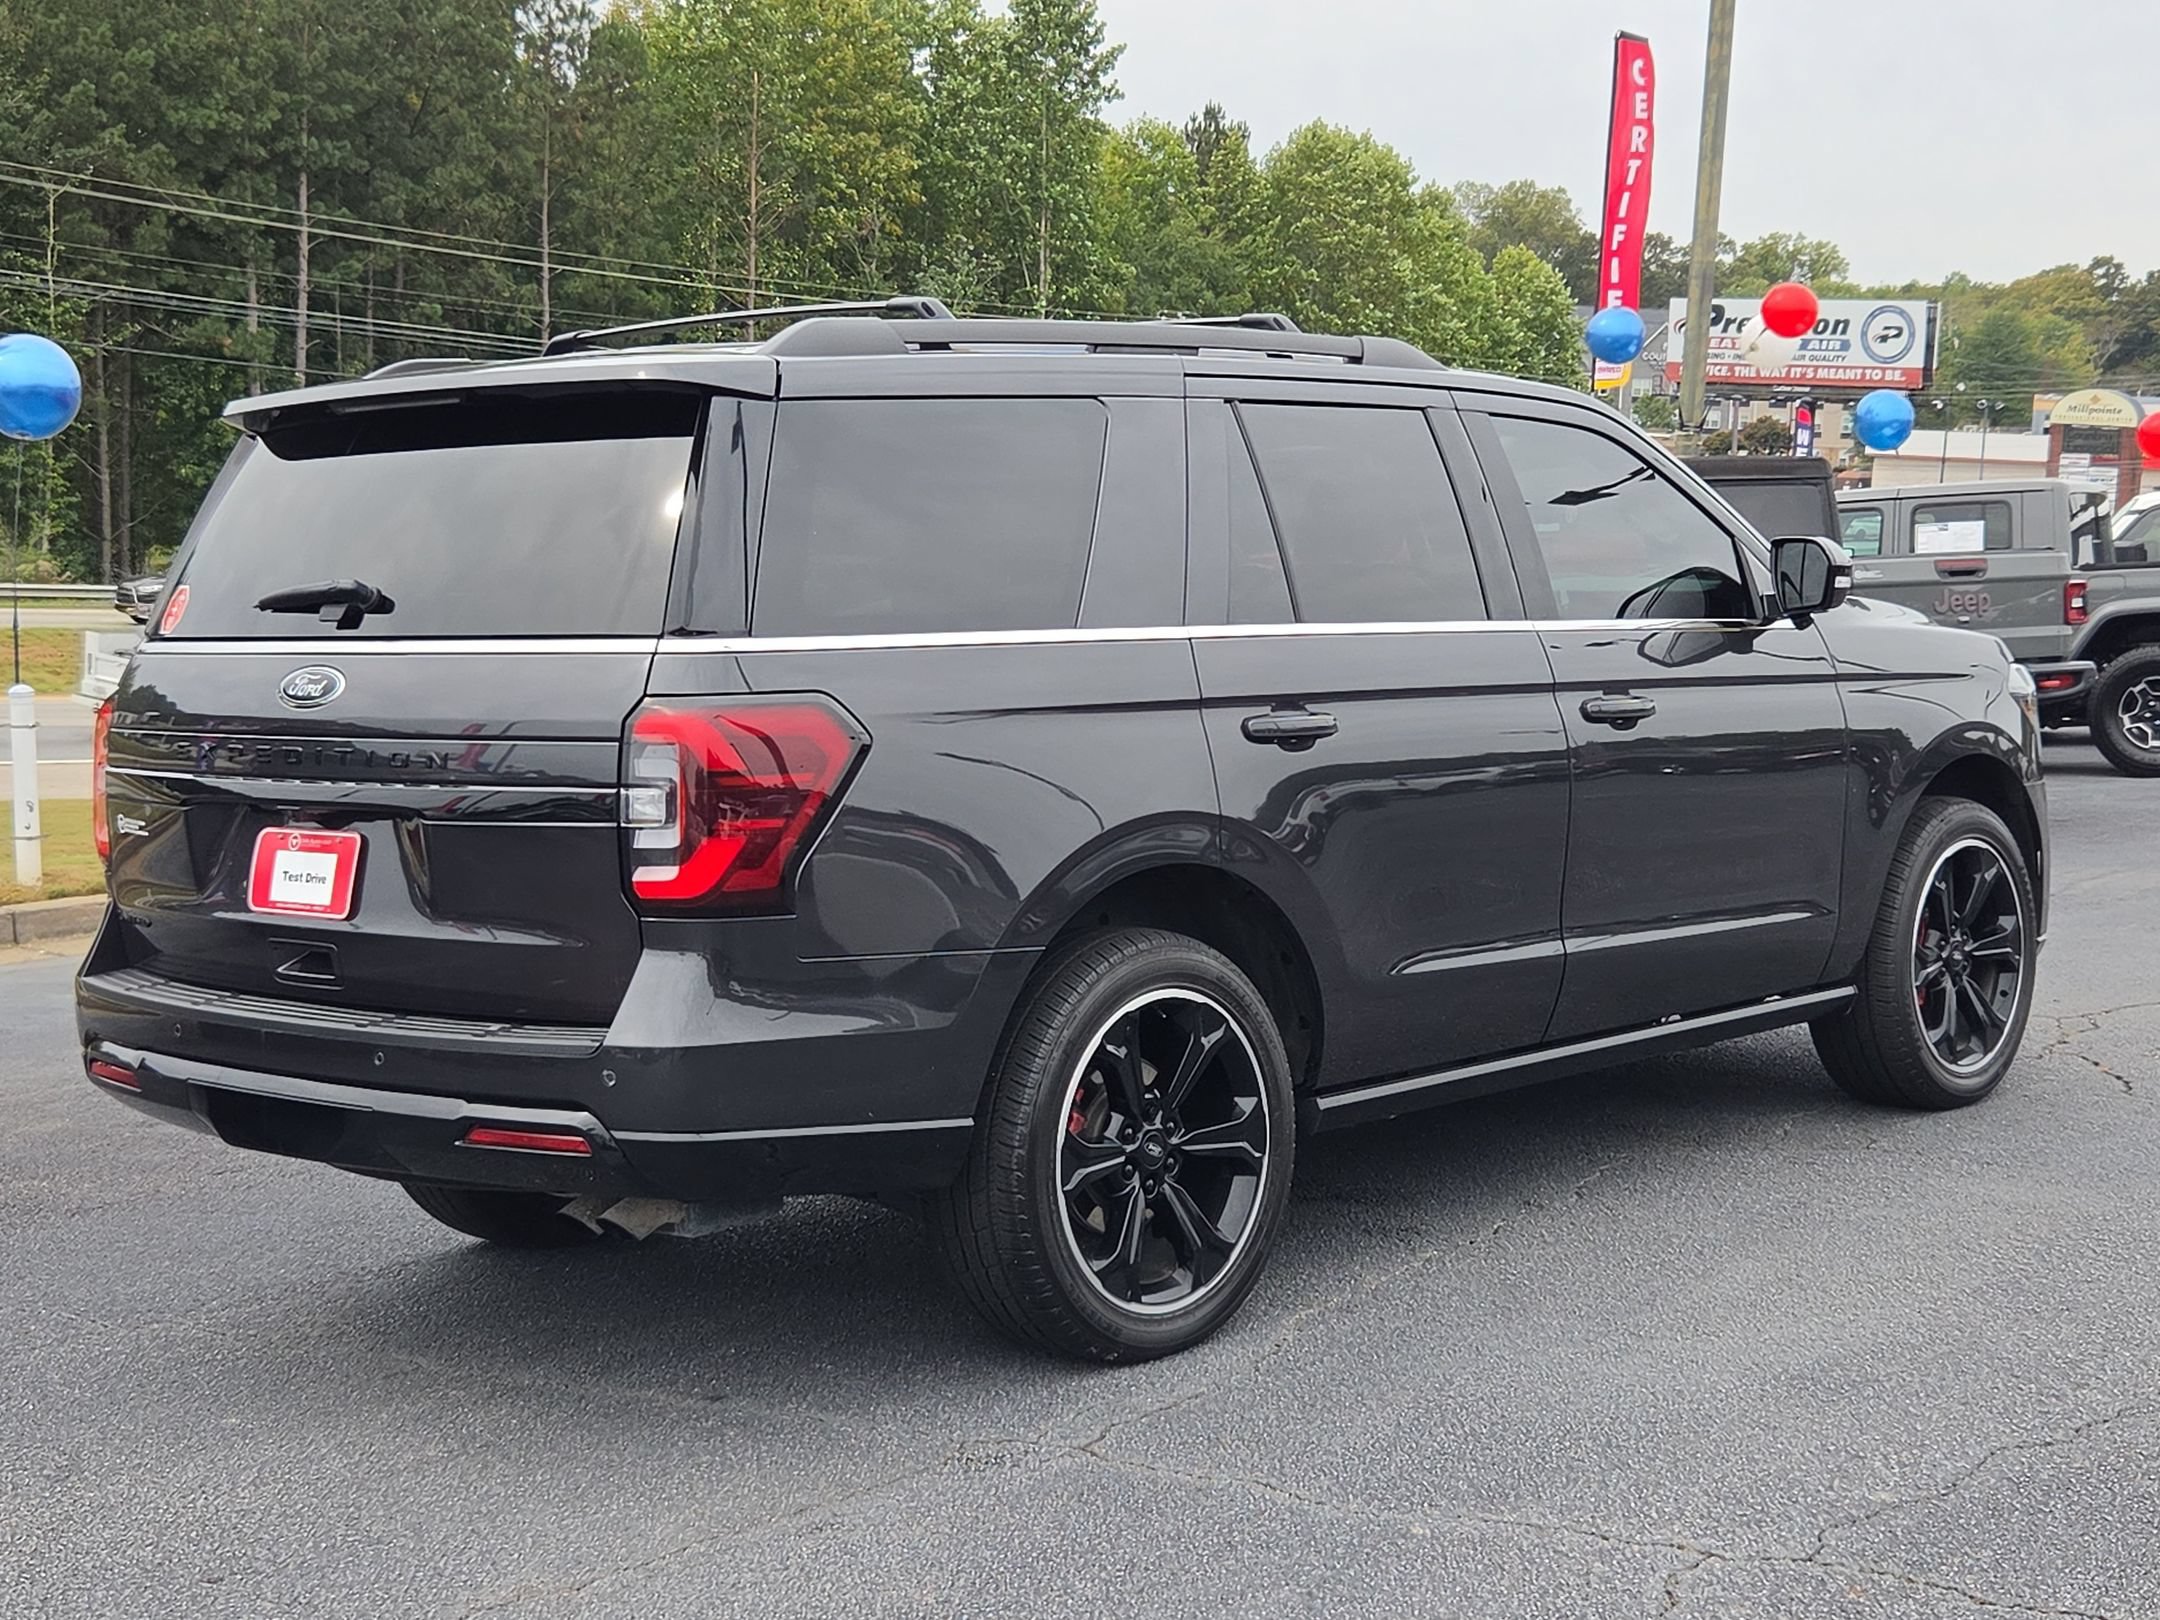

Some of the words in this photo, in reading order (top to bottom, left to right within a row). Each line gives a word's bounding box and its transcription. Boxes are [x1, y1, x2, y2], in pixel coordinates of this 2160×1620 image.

[1606, 58, 1649, 309] CERTIFIE
[1807, 340, 1841, 350] AIR
[1808, 354, 1847, 362] QUALITY
[1734, 366, 1757, 377] THE
[1759, 366, 1788, 378] WAY
[1790, 367, 1815, 378] IT'S
[1816, 368, 1862, 380] MEANT
[1864, 370, 1883, 381] TO
[1885, 371, 1907, 381] BE.
[2066, 404, 2123, 415] Millpointe
[1934, 587, 1991, 617] Jeep
[288, 673, 327, 698] Ford
[283, 871, 303, 882] Test
[305, 873, 327, 884] Drive
